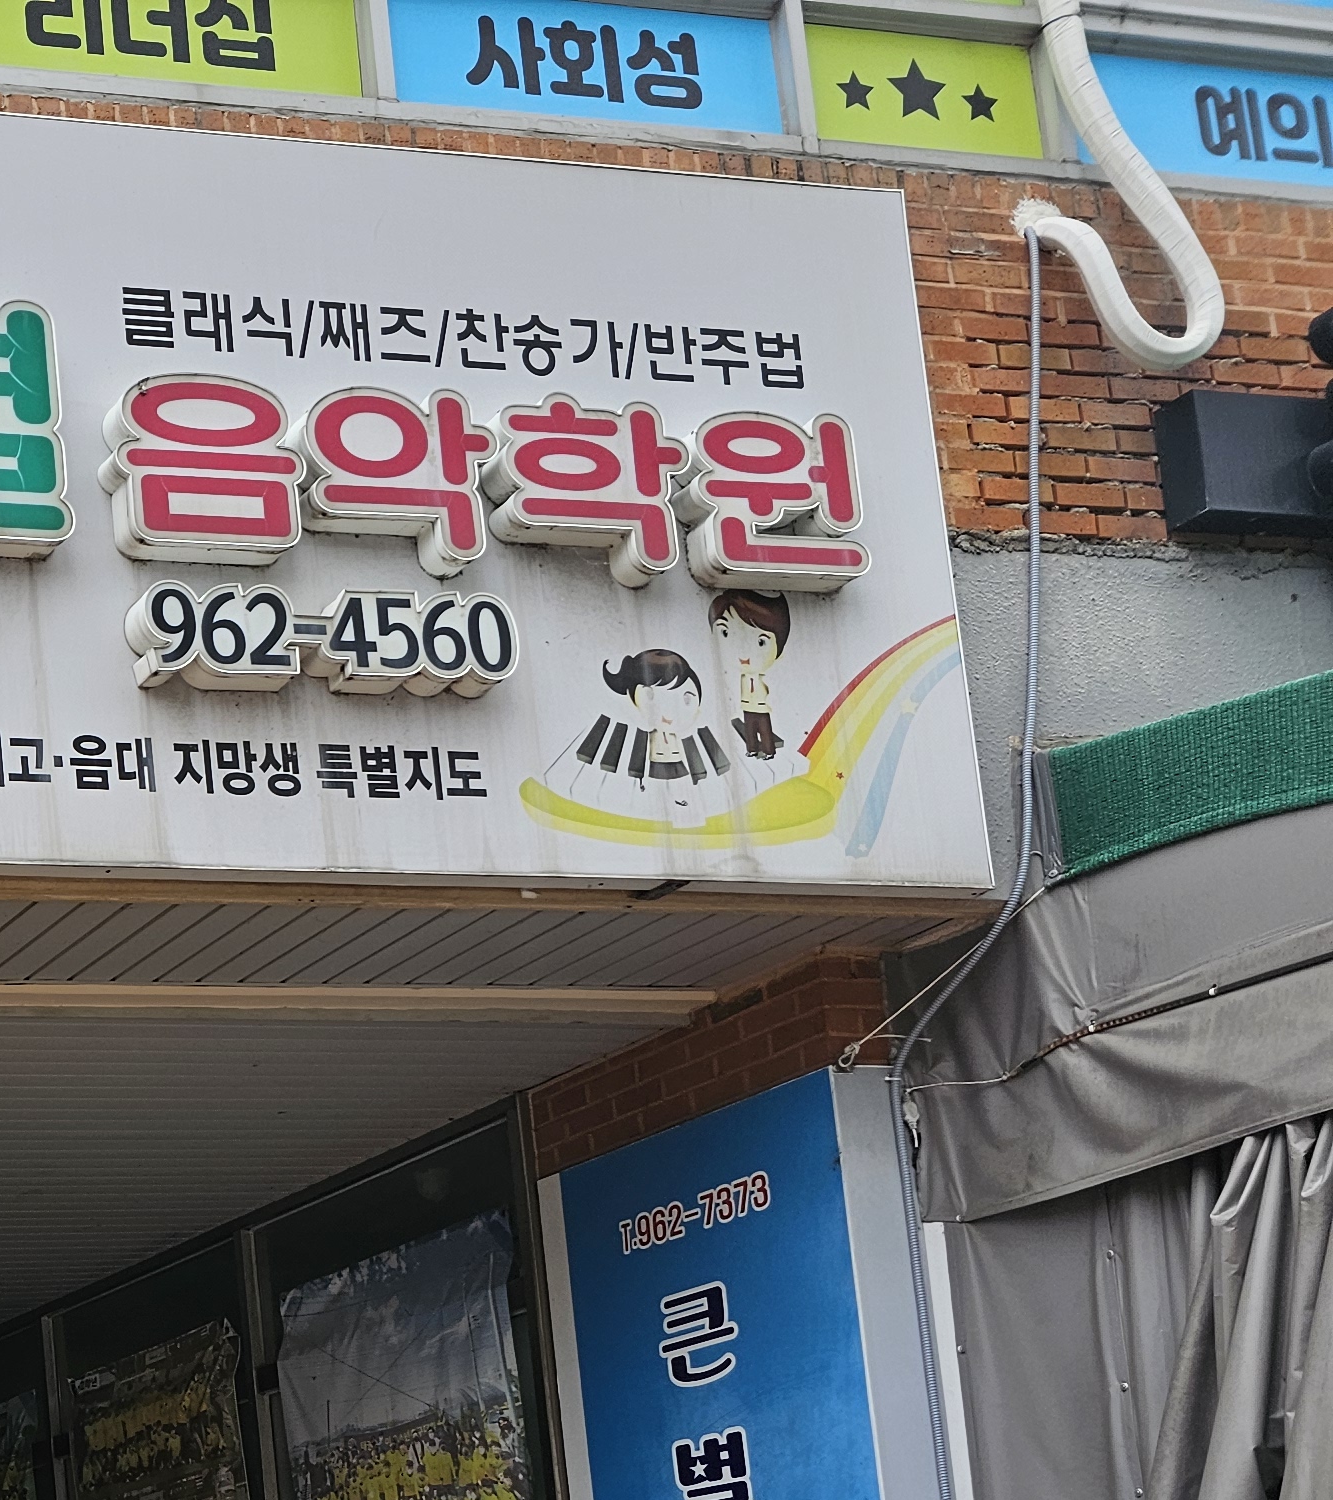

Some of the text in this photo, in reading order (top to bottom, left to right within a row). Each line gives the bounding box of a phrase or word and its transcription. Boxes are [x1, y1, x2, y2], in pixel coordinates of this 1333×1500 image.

[466, 14, 703, 110] 사회성
[121, 375, 867, 570] 음악학원
[145, 584, 515, 678] 962-4560
[173, 740, 301, 797] 지망생
[316, 742, 488, 802] 특별지도
[620, 1172, 771, 1254] T.962-7373
